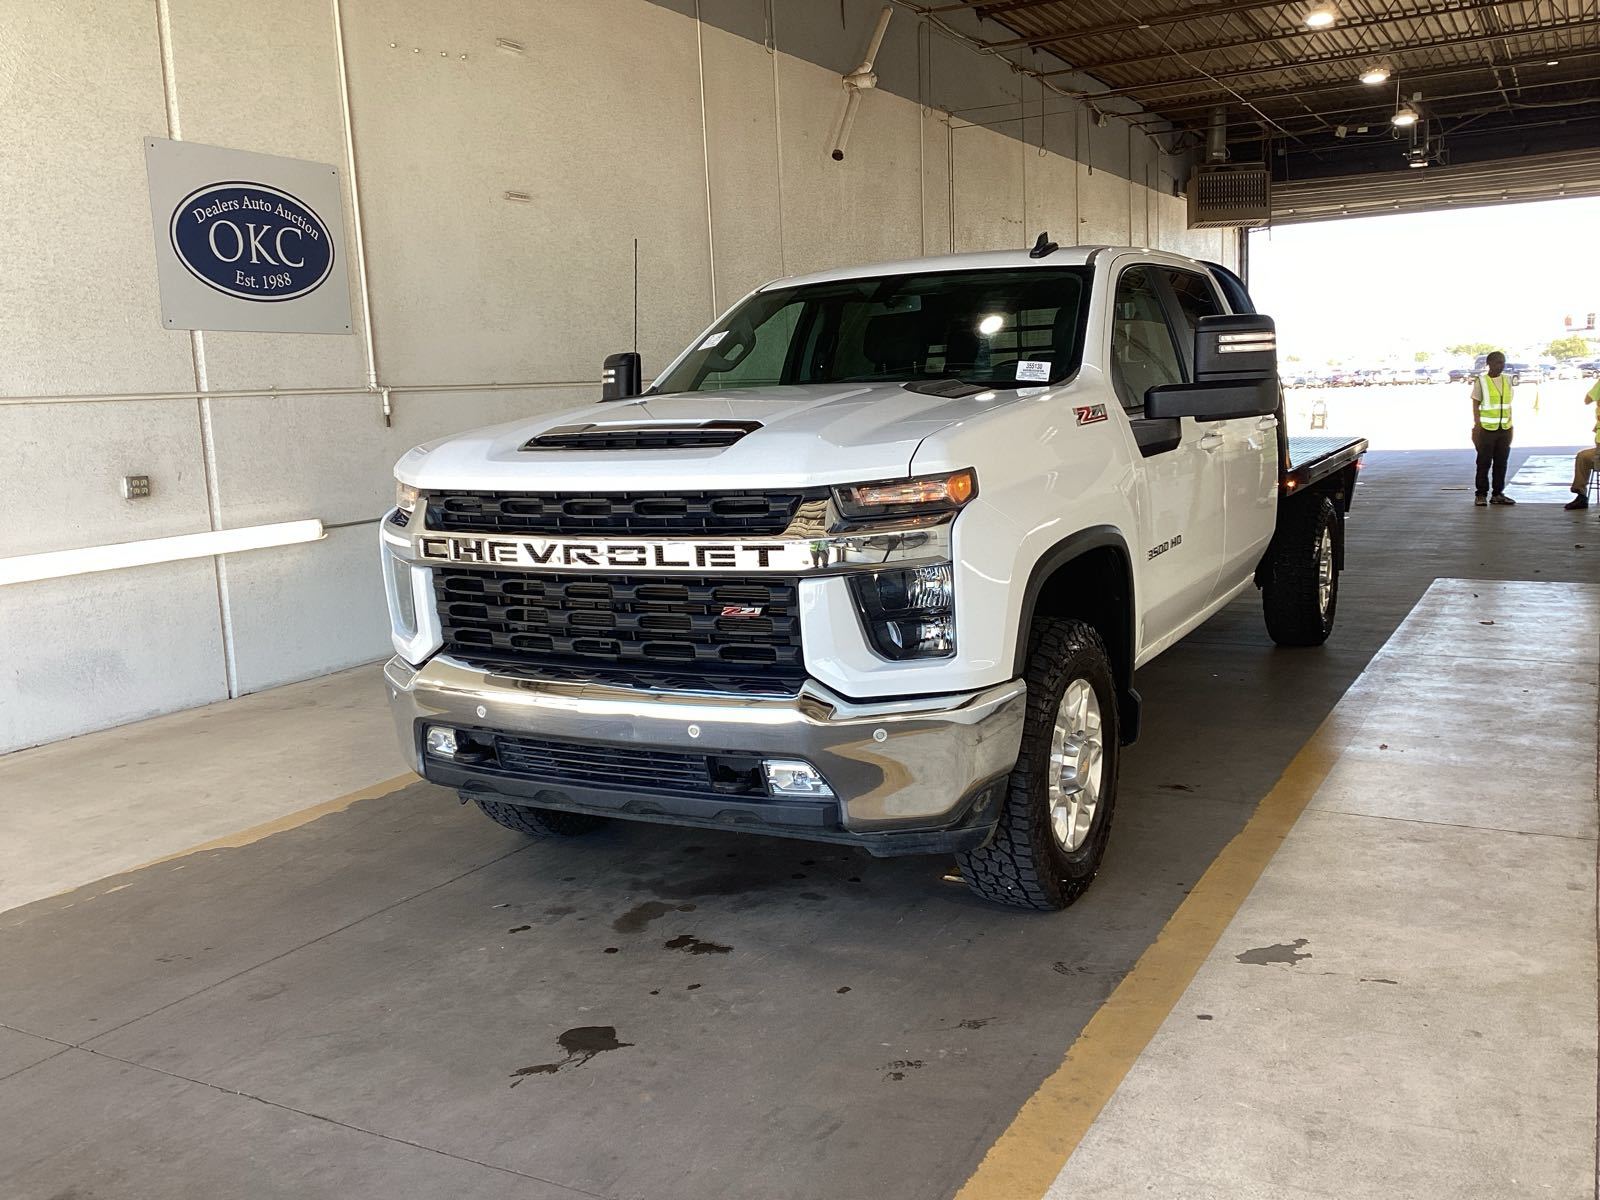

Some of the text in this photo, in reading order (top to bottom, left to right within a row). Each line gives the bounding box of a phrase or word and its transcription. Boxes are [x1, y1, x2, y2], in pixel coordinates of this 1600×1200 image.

[192, 195, 319, 241] Dealers Auto Auction
[208, 219, 305, 268] OKC
[235, 269, 292, 290] Est. 1988
[420, 538, 785, 568] CHEVROLET
[1148, 534, 1182, 561] 3500 HD
